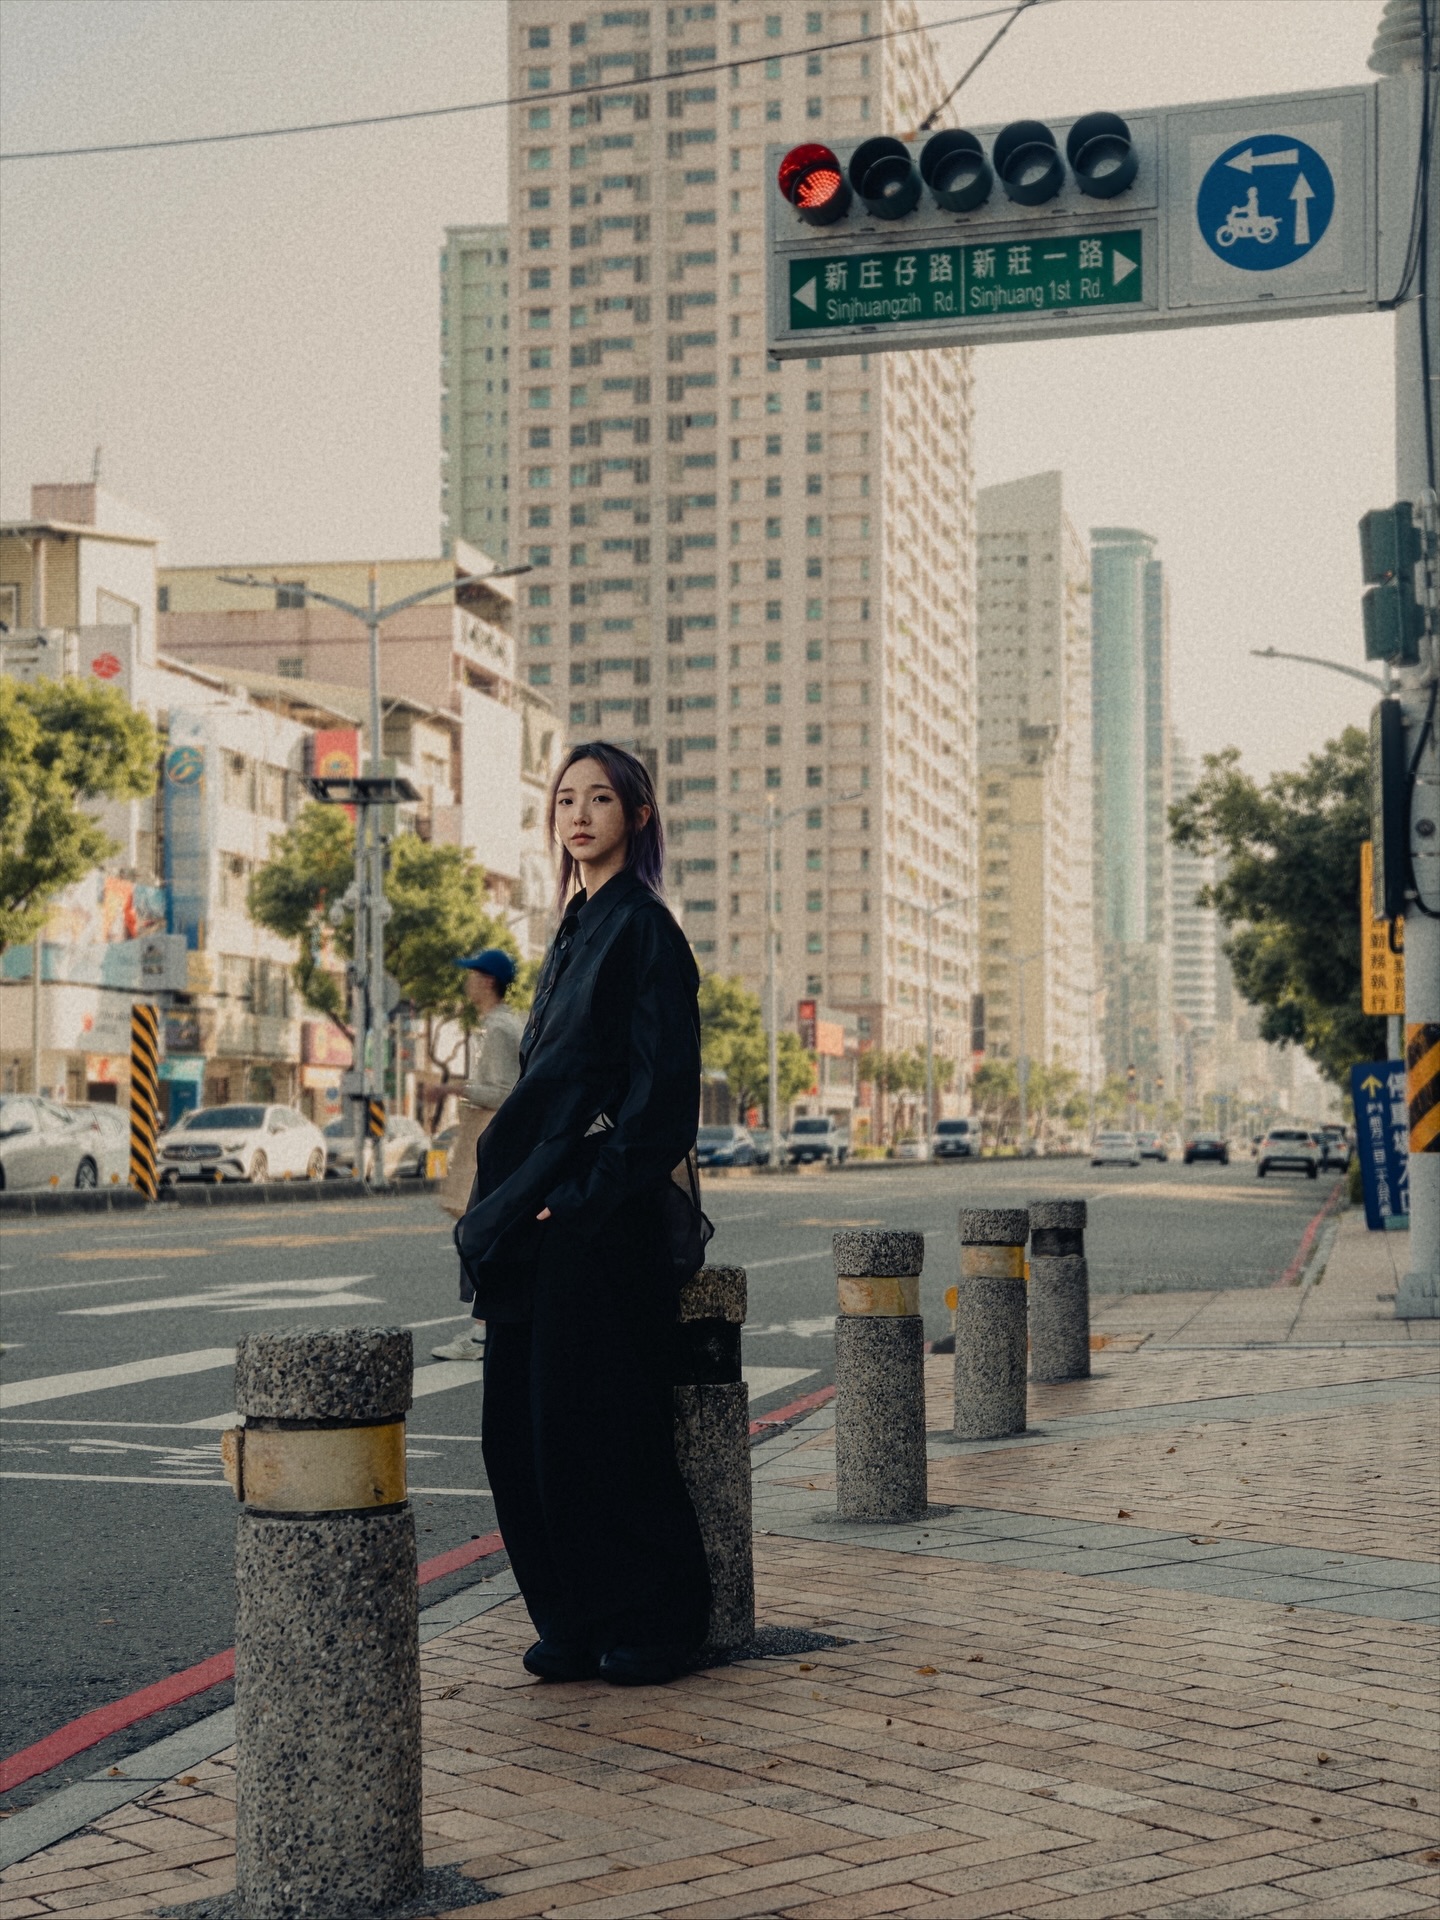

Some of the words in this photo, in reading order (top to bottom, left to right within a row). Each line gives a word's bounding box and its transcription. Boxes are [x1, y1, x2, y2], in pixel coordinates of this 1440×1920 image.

[824, 253, 953, 292] 新庄仔路
[972, 239, 1104, 279] 新莊一路
[826, 292, 921, 323] Sinjhuangzih
[934, 291, 958, 313] Rd.
[970, 284, 1044, 312] Sinjhuang
[1049, 279, 1071, 301] 1st
[1080, 277, 1104, 300] Rd.
